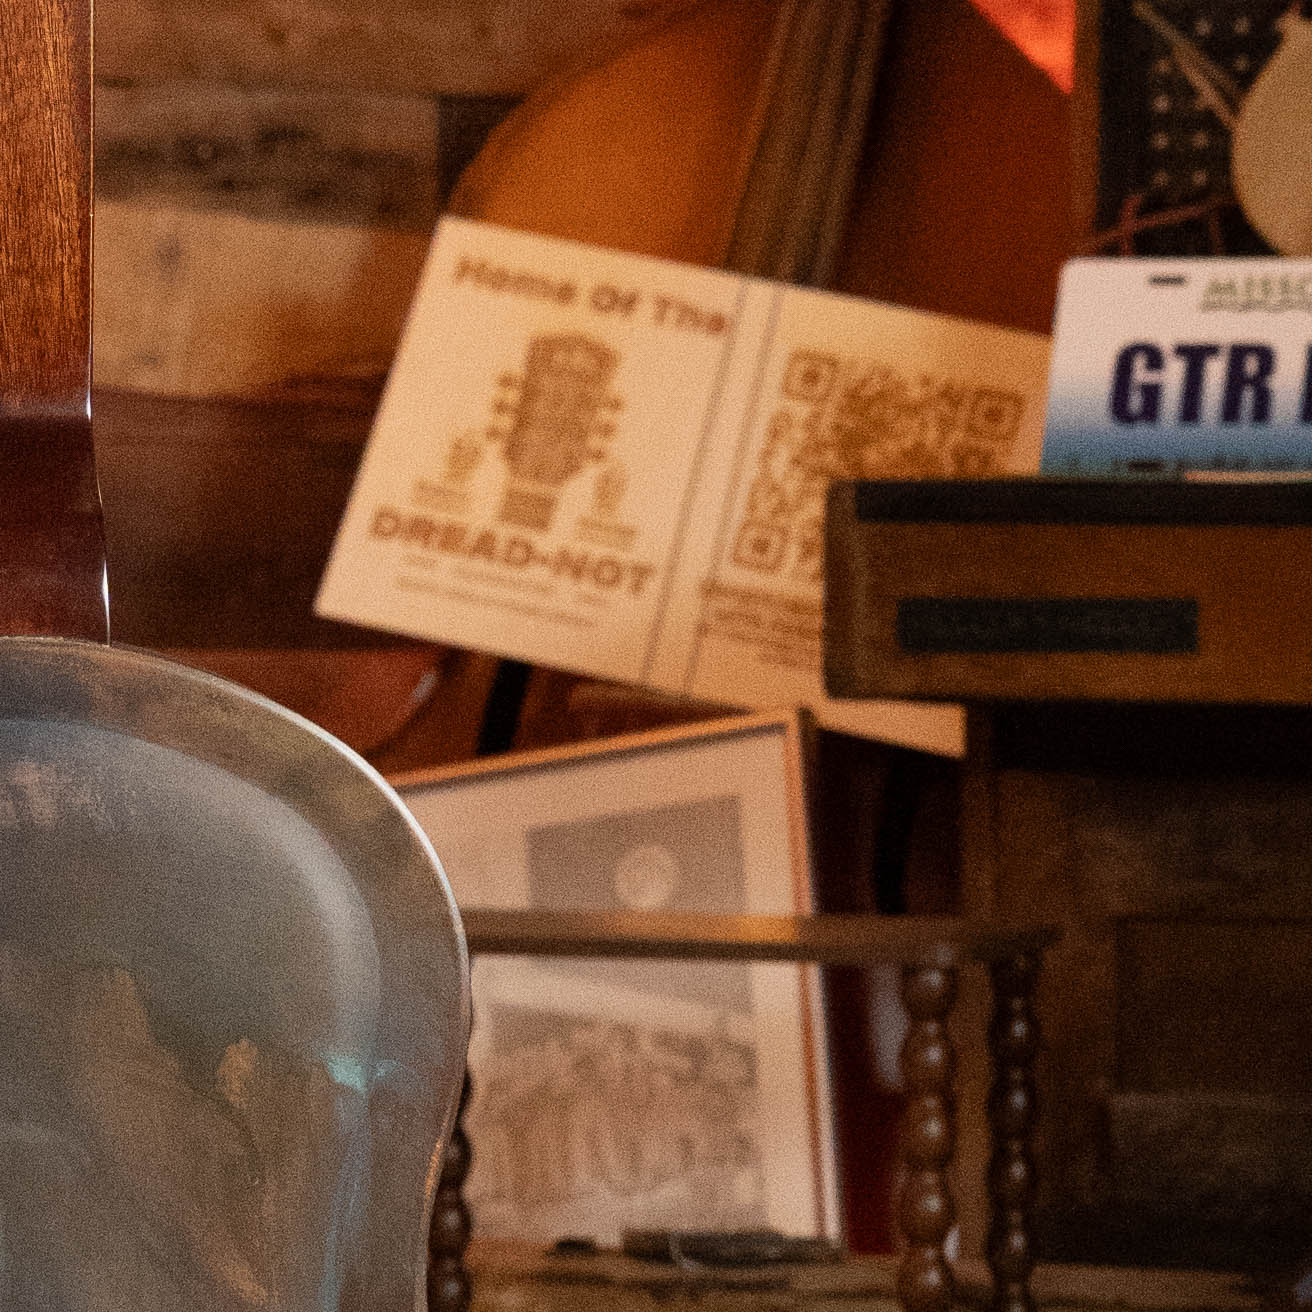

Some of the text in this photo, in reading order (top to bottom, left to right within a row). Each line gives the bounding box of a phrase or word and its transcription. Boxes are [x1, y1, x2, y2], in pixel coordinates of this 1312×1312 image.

[650, 295, 733, 337] The
[1109, 341, 1276, 426] GTR
[368, 507, 656, 598] DREAD-NOT
